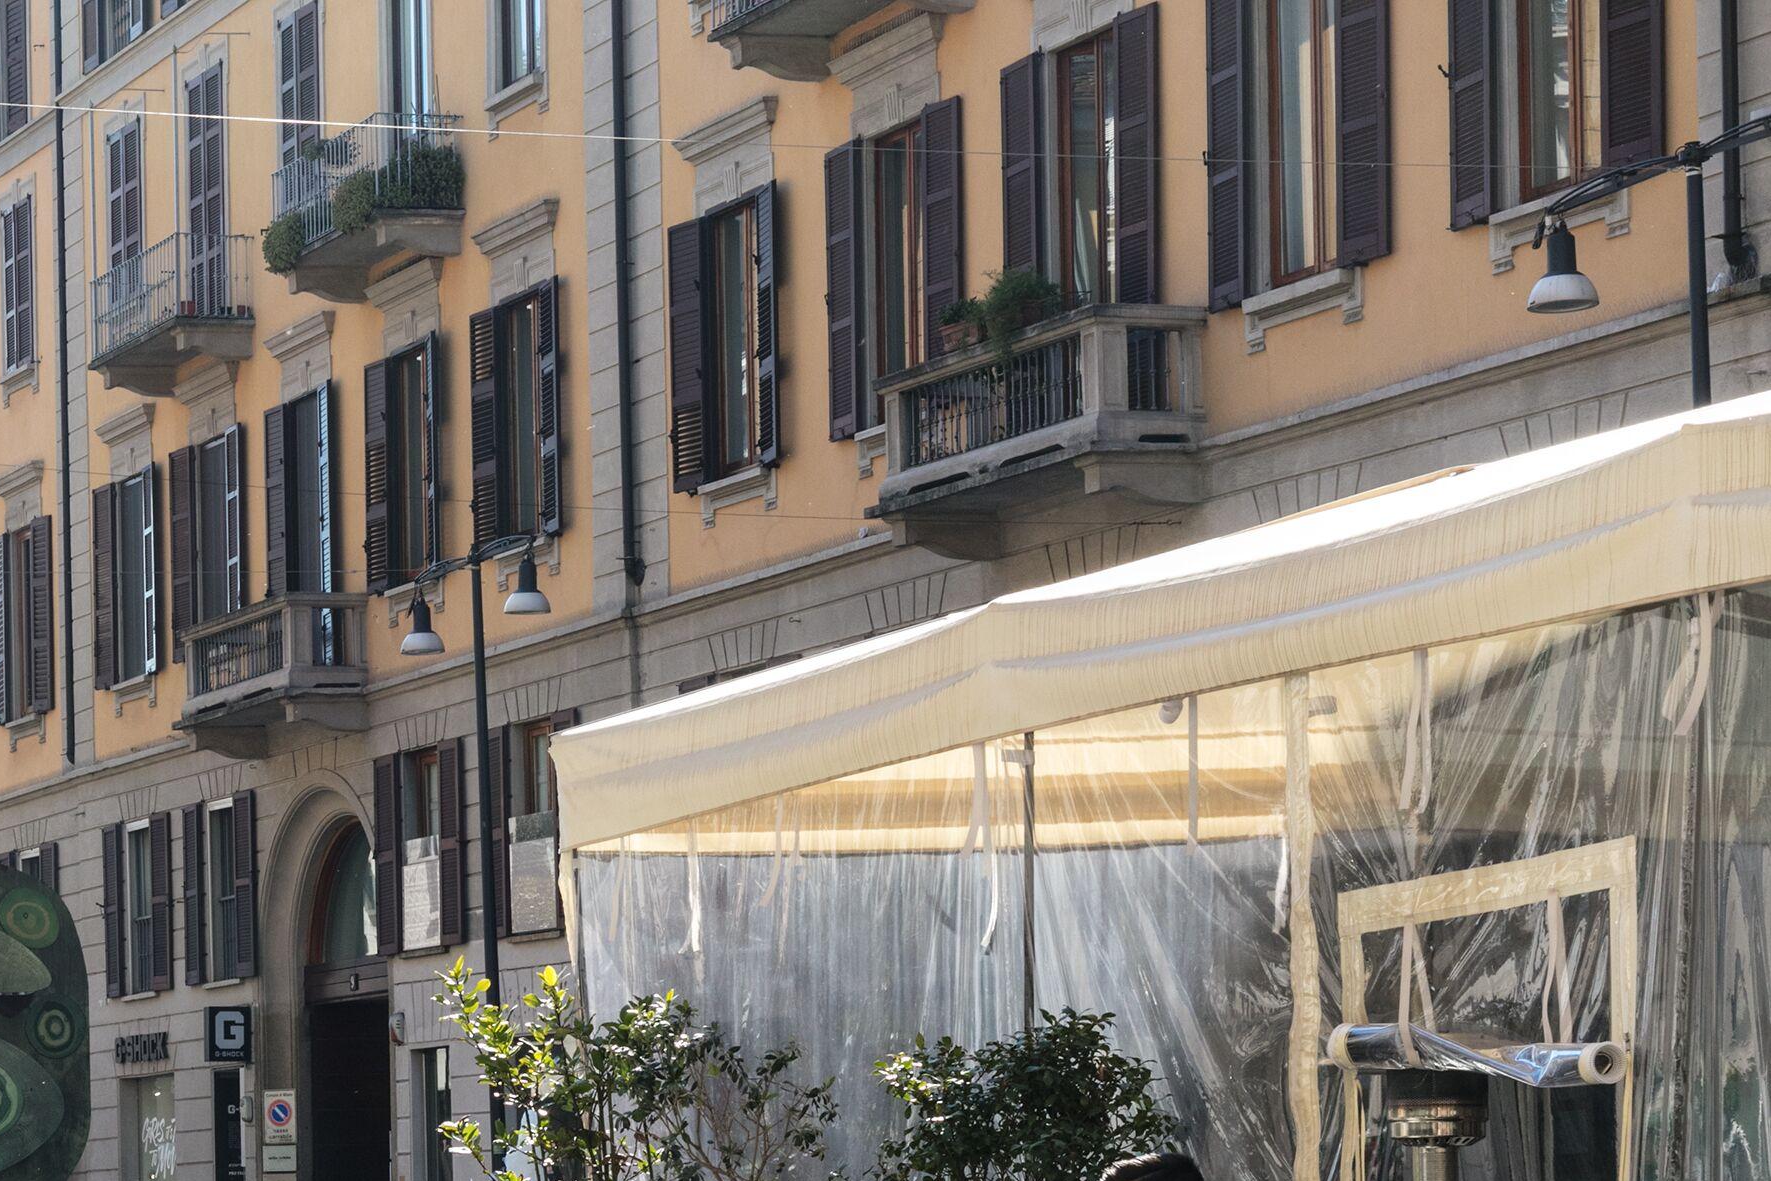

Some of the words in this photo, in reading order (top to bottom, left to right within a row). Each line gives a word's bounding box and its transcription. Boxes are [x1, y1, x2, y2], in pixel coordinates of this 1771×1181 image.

[214, 1010, 245, 1050] G
[114, 1031, 169, 1064] G-SHOCK
[214, 1050, 245, 1058] G-SHOCK
